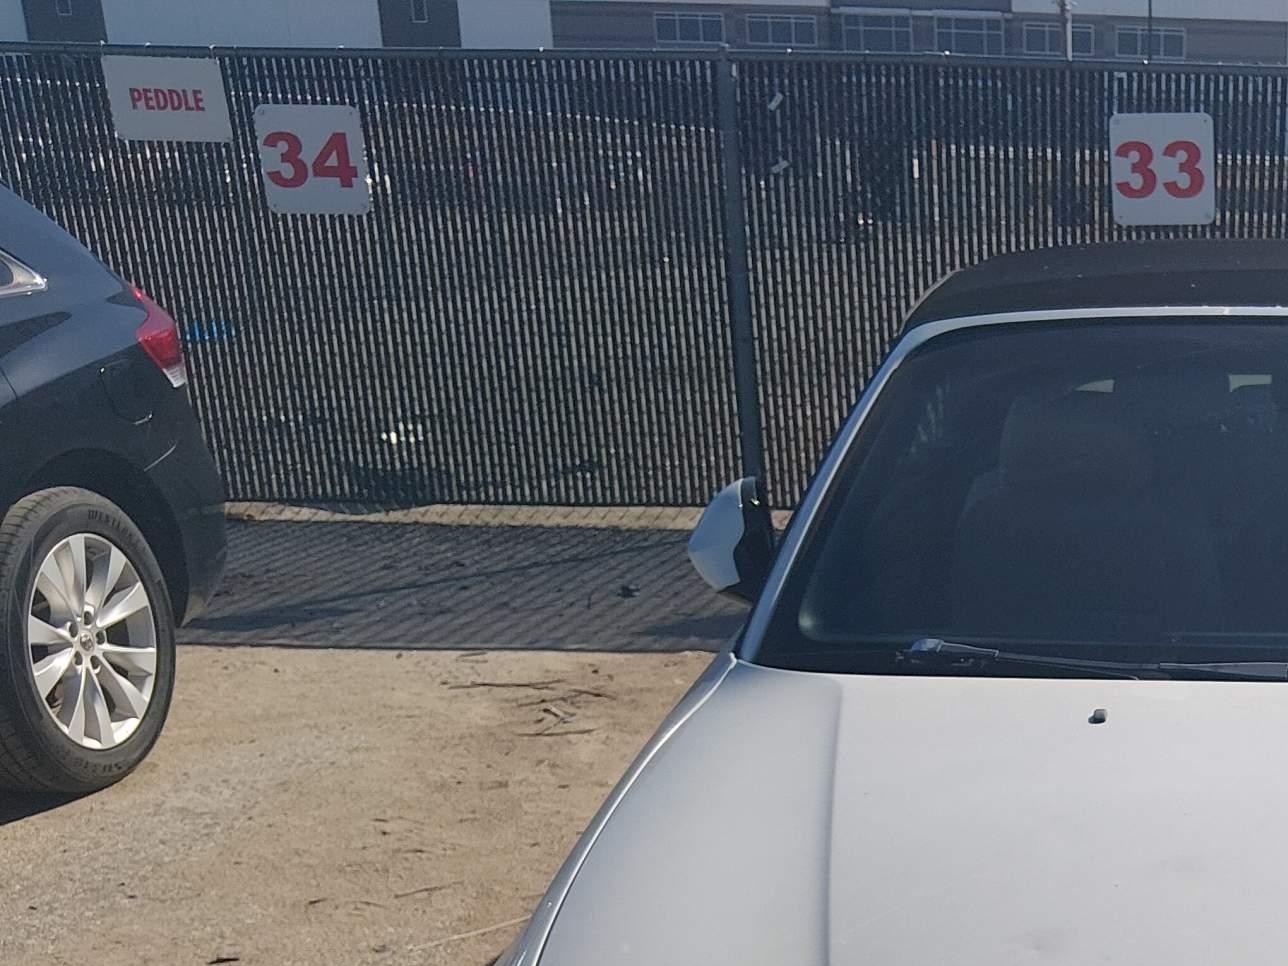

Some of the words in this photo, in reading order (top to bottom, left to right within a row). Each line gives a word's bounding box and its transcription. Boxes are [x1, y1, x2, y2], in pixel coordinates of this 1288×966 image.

[129, 87, 206, 112] PEDDLE
[262, 131, 358, 188] 34
[1115, 141, 1205, 199] 33
